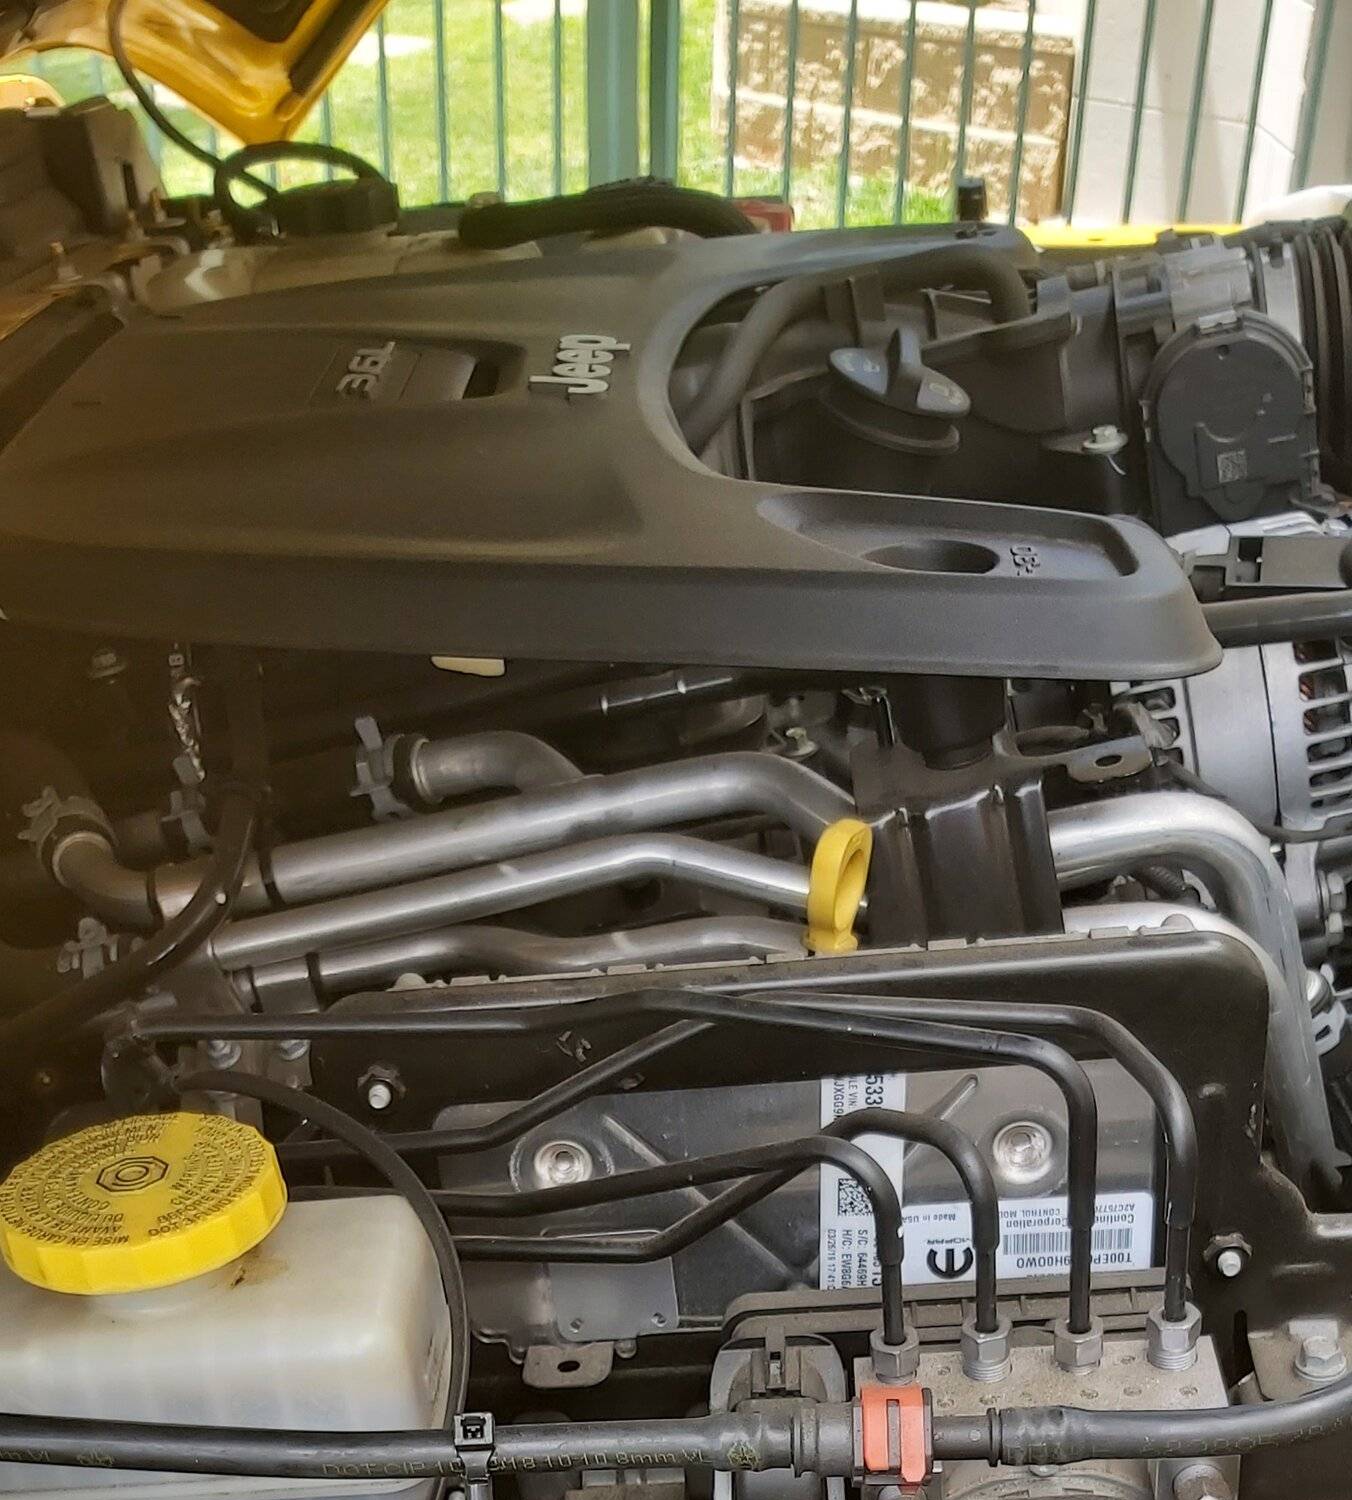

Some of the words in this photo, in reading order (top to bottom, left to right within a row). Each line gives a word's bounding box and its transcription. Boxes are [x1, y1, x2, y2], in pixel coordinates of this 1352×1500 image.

[528, 334, 632, 394] Jeep
[155, 1194, 218, 1225] BEFORE
[1021, 1207, 1061, 1218] CONTROL
[147, 1223, 183, 1239] DOT
[179, 1216, 196, 1226] 3
[190, 1197, 235, 1221] FLUID
[901, 1215, 920, 1225] USA
[932, 1213, 956, 1222] Made
[1006, 1216, 1068, 1230] Corporation
[1092, 1213, 1135, 1226] Contin
[66, 1224, 121, 1235] AVANT
[63, 1236, 91, 1246] EN
[89, 1234, 129, 1246] MISE
[841, 1253, 852, 1289] EW8G6
